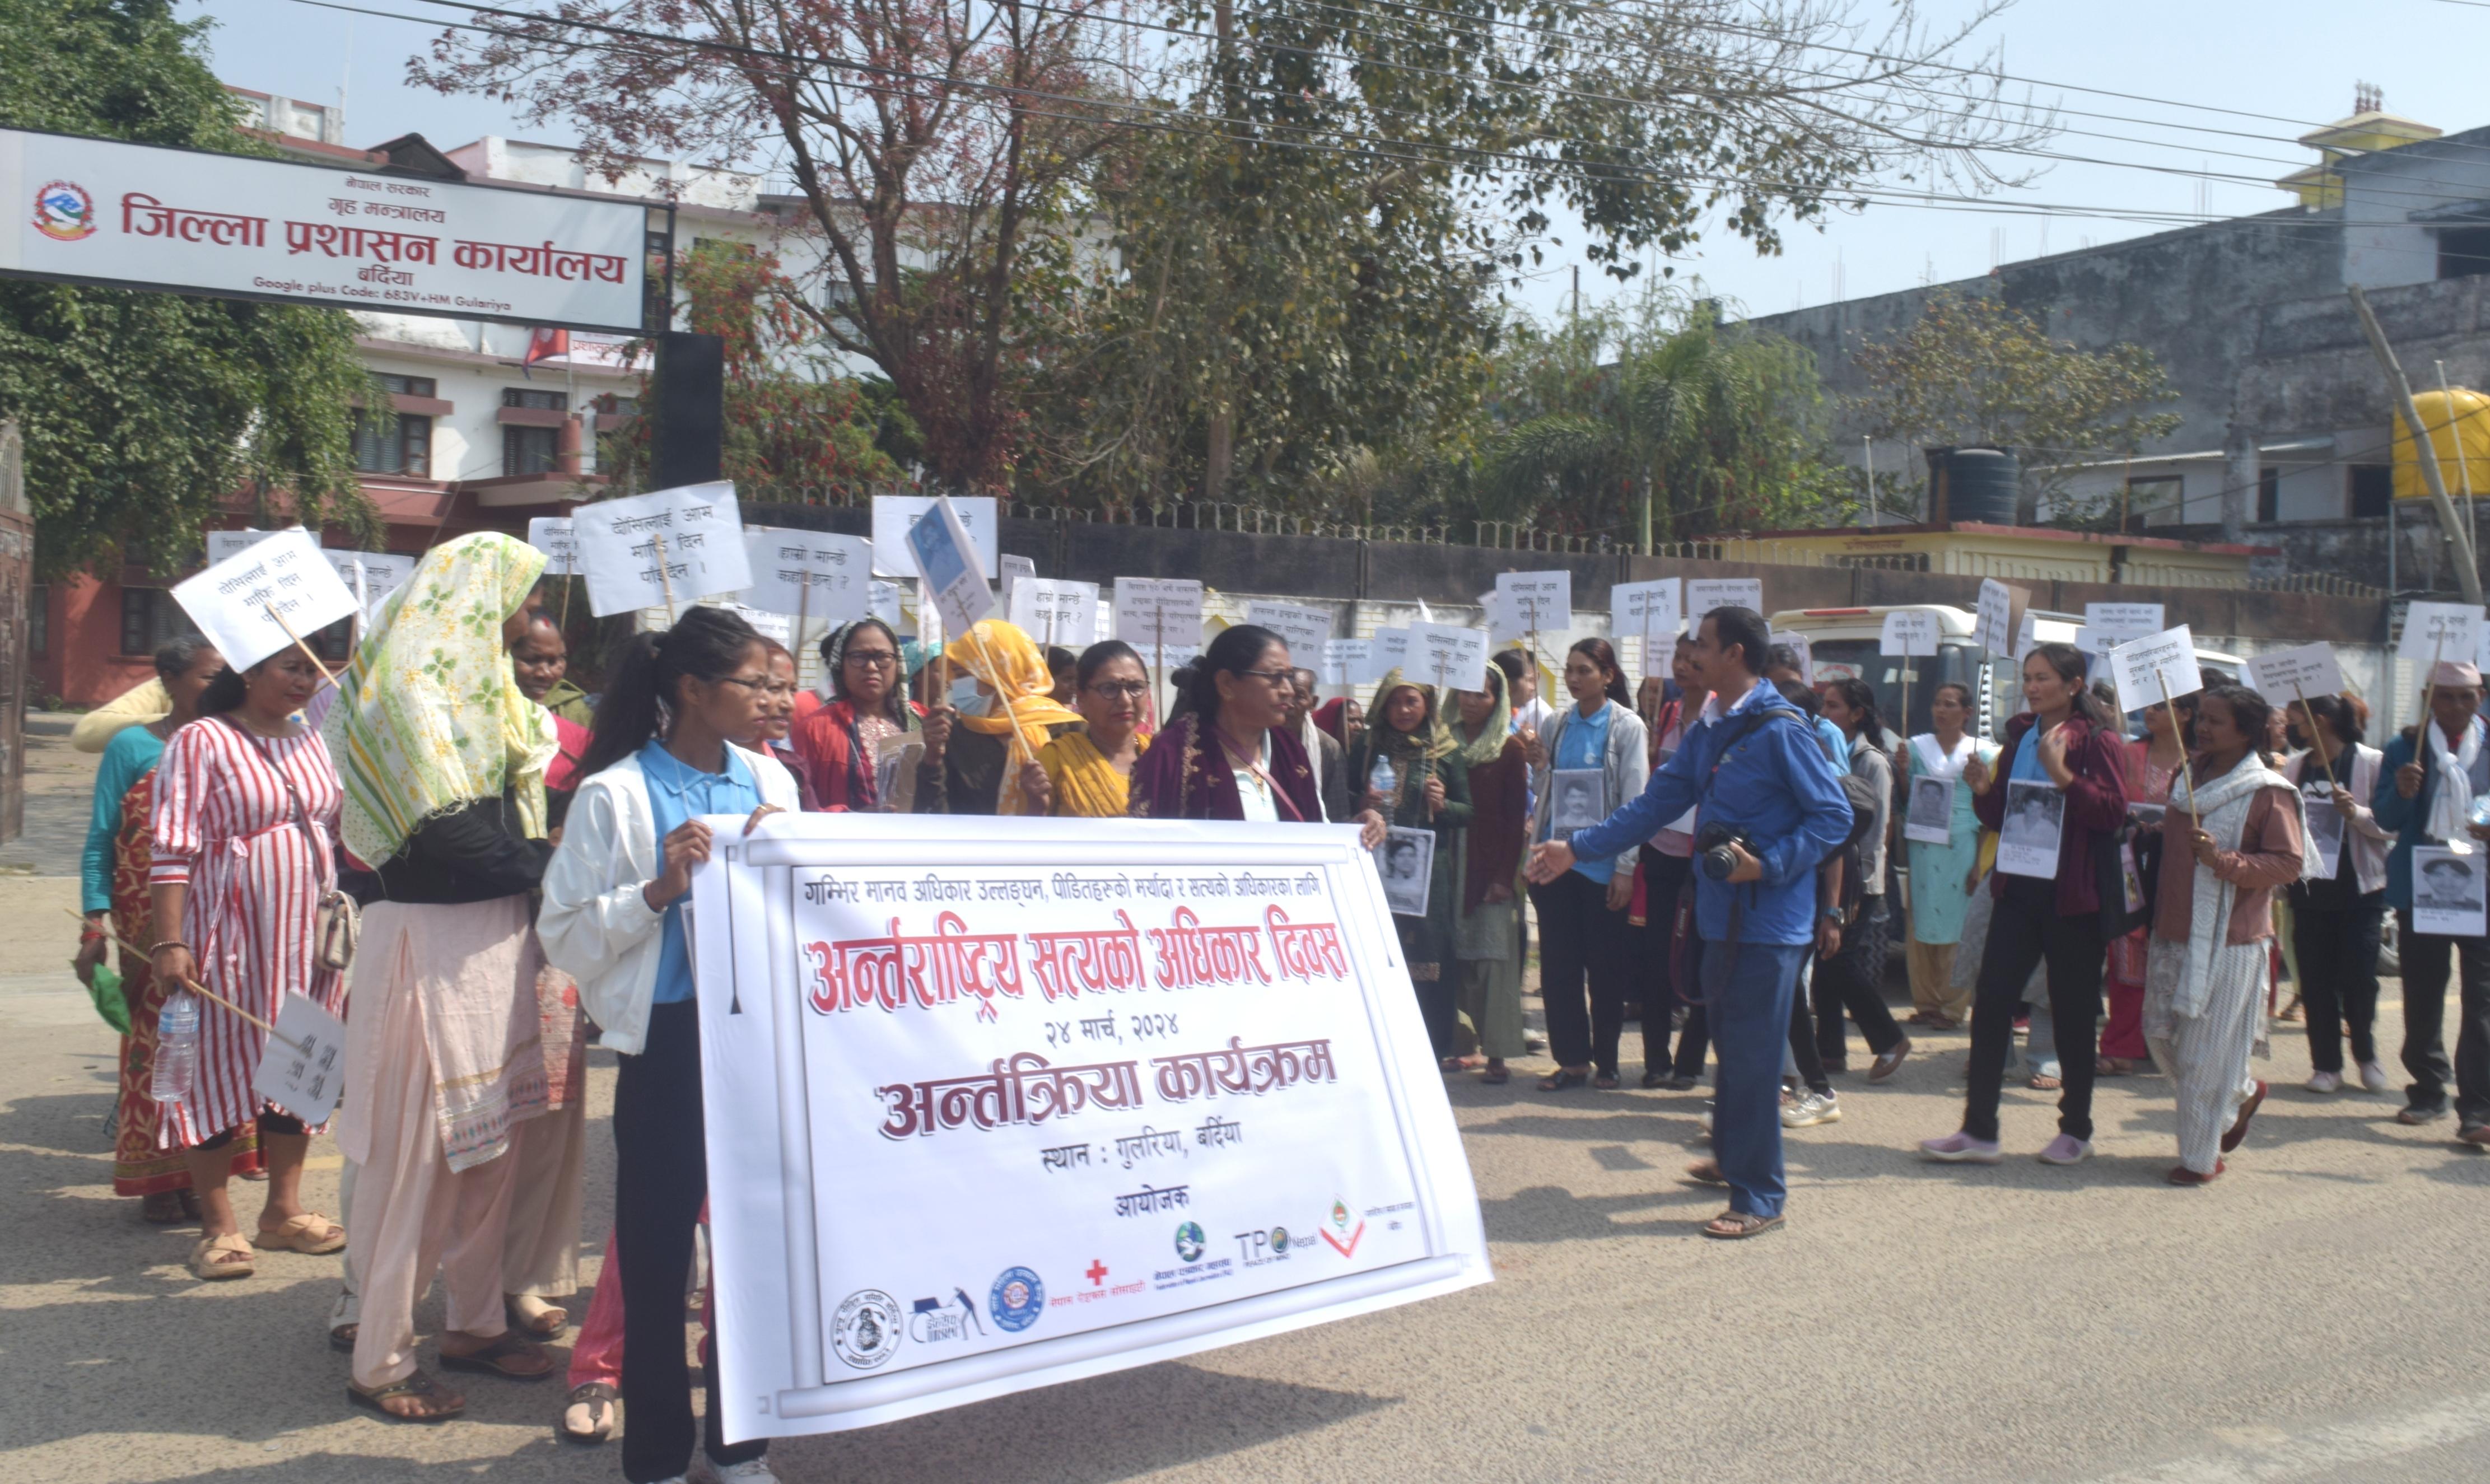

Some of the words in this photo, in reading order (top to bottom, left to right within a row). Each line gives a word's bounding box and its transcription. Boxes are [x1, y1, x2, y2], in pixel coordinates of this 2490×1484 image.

[345, 175, 381, 191] नेपाल
[386, 183, 431, 197] सरकार
[328, 198, 358, 216] गृह
[364, 202, 446, 223] मन्त्रालय
[121, 192, 269, 248] जिल्ला
[285, 220, 440, 265] प्रशासन
[453, 240, 628, 284] कार्यालय
[358, 264, 414, 286] बर्दिया
[253, 276, 303, 293] Google
[308, 282, 336, 295] plus
[341, 286, 379, 298] Code:
[384, 290, 450, 305] 683V+HM
[455, 297, 512, 311] Gulariya
[681, 505, 714, 522] आम
[677, 532, 705, 550] दिन
[271, 550, 298, 567] आम
[277, 573, 302, 590] दिन
[804, 874, 860, 905] गम्भिर
[864, 880, 907, 902] मानव
[913, 873, 972, 902] अधिकार
[1134, 872, 1174, 899] मर्यादा
[1176, 878, 1185, 897] र
[1188, 872, 1232, 898] सत्यको
[1234, 872, 1292, 897] अधिकारका
[1294, 872, 1322, 895] लागि
[1026, 908, 1148, 1004] सत्यको
[1147, 905, 1272, 991] अधिकार
[1263, 903, 1349, 984] दिवस
[1045, 1021, 1070, 1049] २४
[1081, 1014, 1123, 1044] मार्च,
[1132, 1013, 1179, 1039] २०२४
[1150, 1036, 1339, 1102] कार्यक्रम
[1041, 1143, 1090, 1174] स्थान
[1196, 1116, 1243, 1147] बर्दिया
[1113, 1184, 1190, 1218] आयोजक
